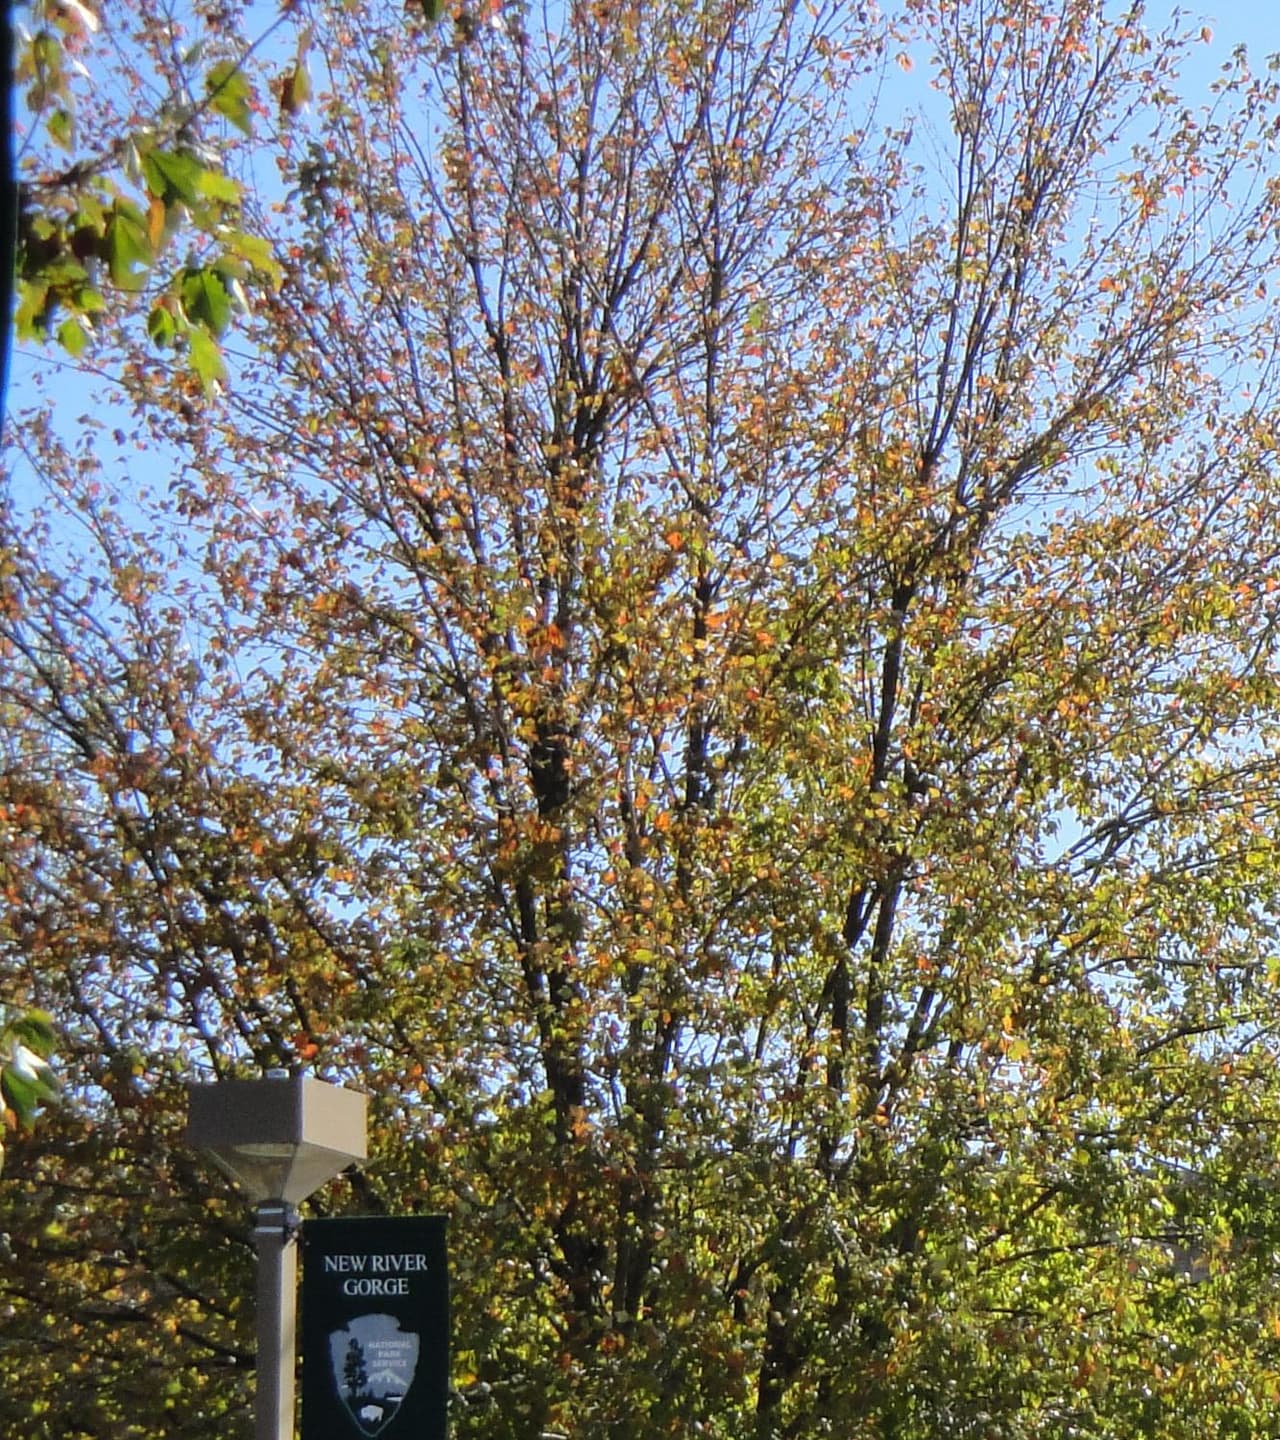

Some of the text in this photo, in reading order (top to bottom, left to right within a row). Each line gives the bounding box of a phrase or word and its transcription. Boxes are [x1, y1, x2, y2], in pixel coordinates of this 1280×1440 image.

[324, 1254, 428, 1272] NEW RIVER
[343, 1278, 409, 1295] GORGE
